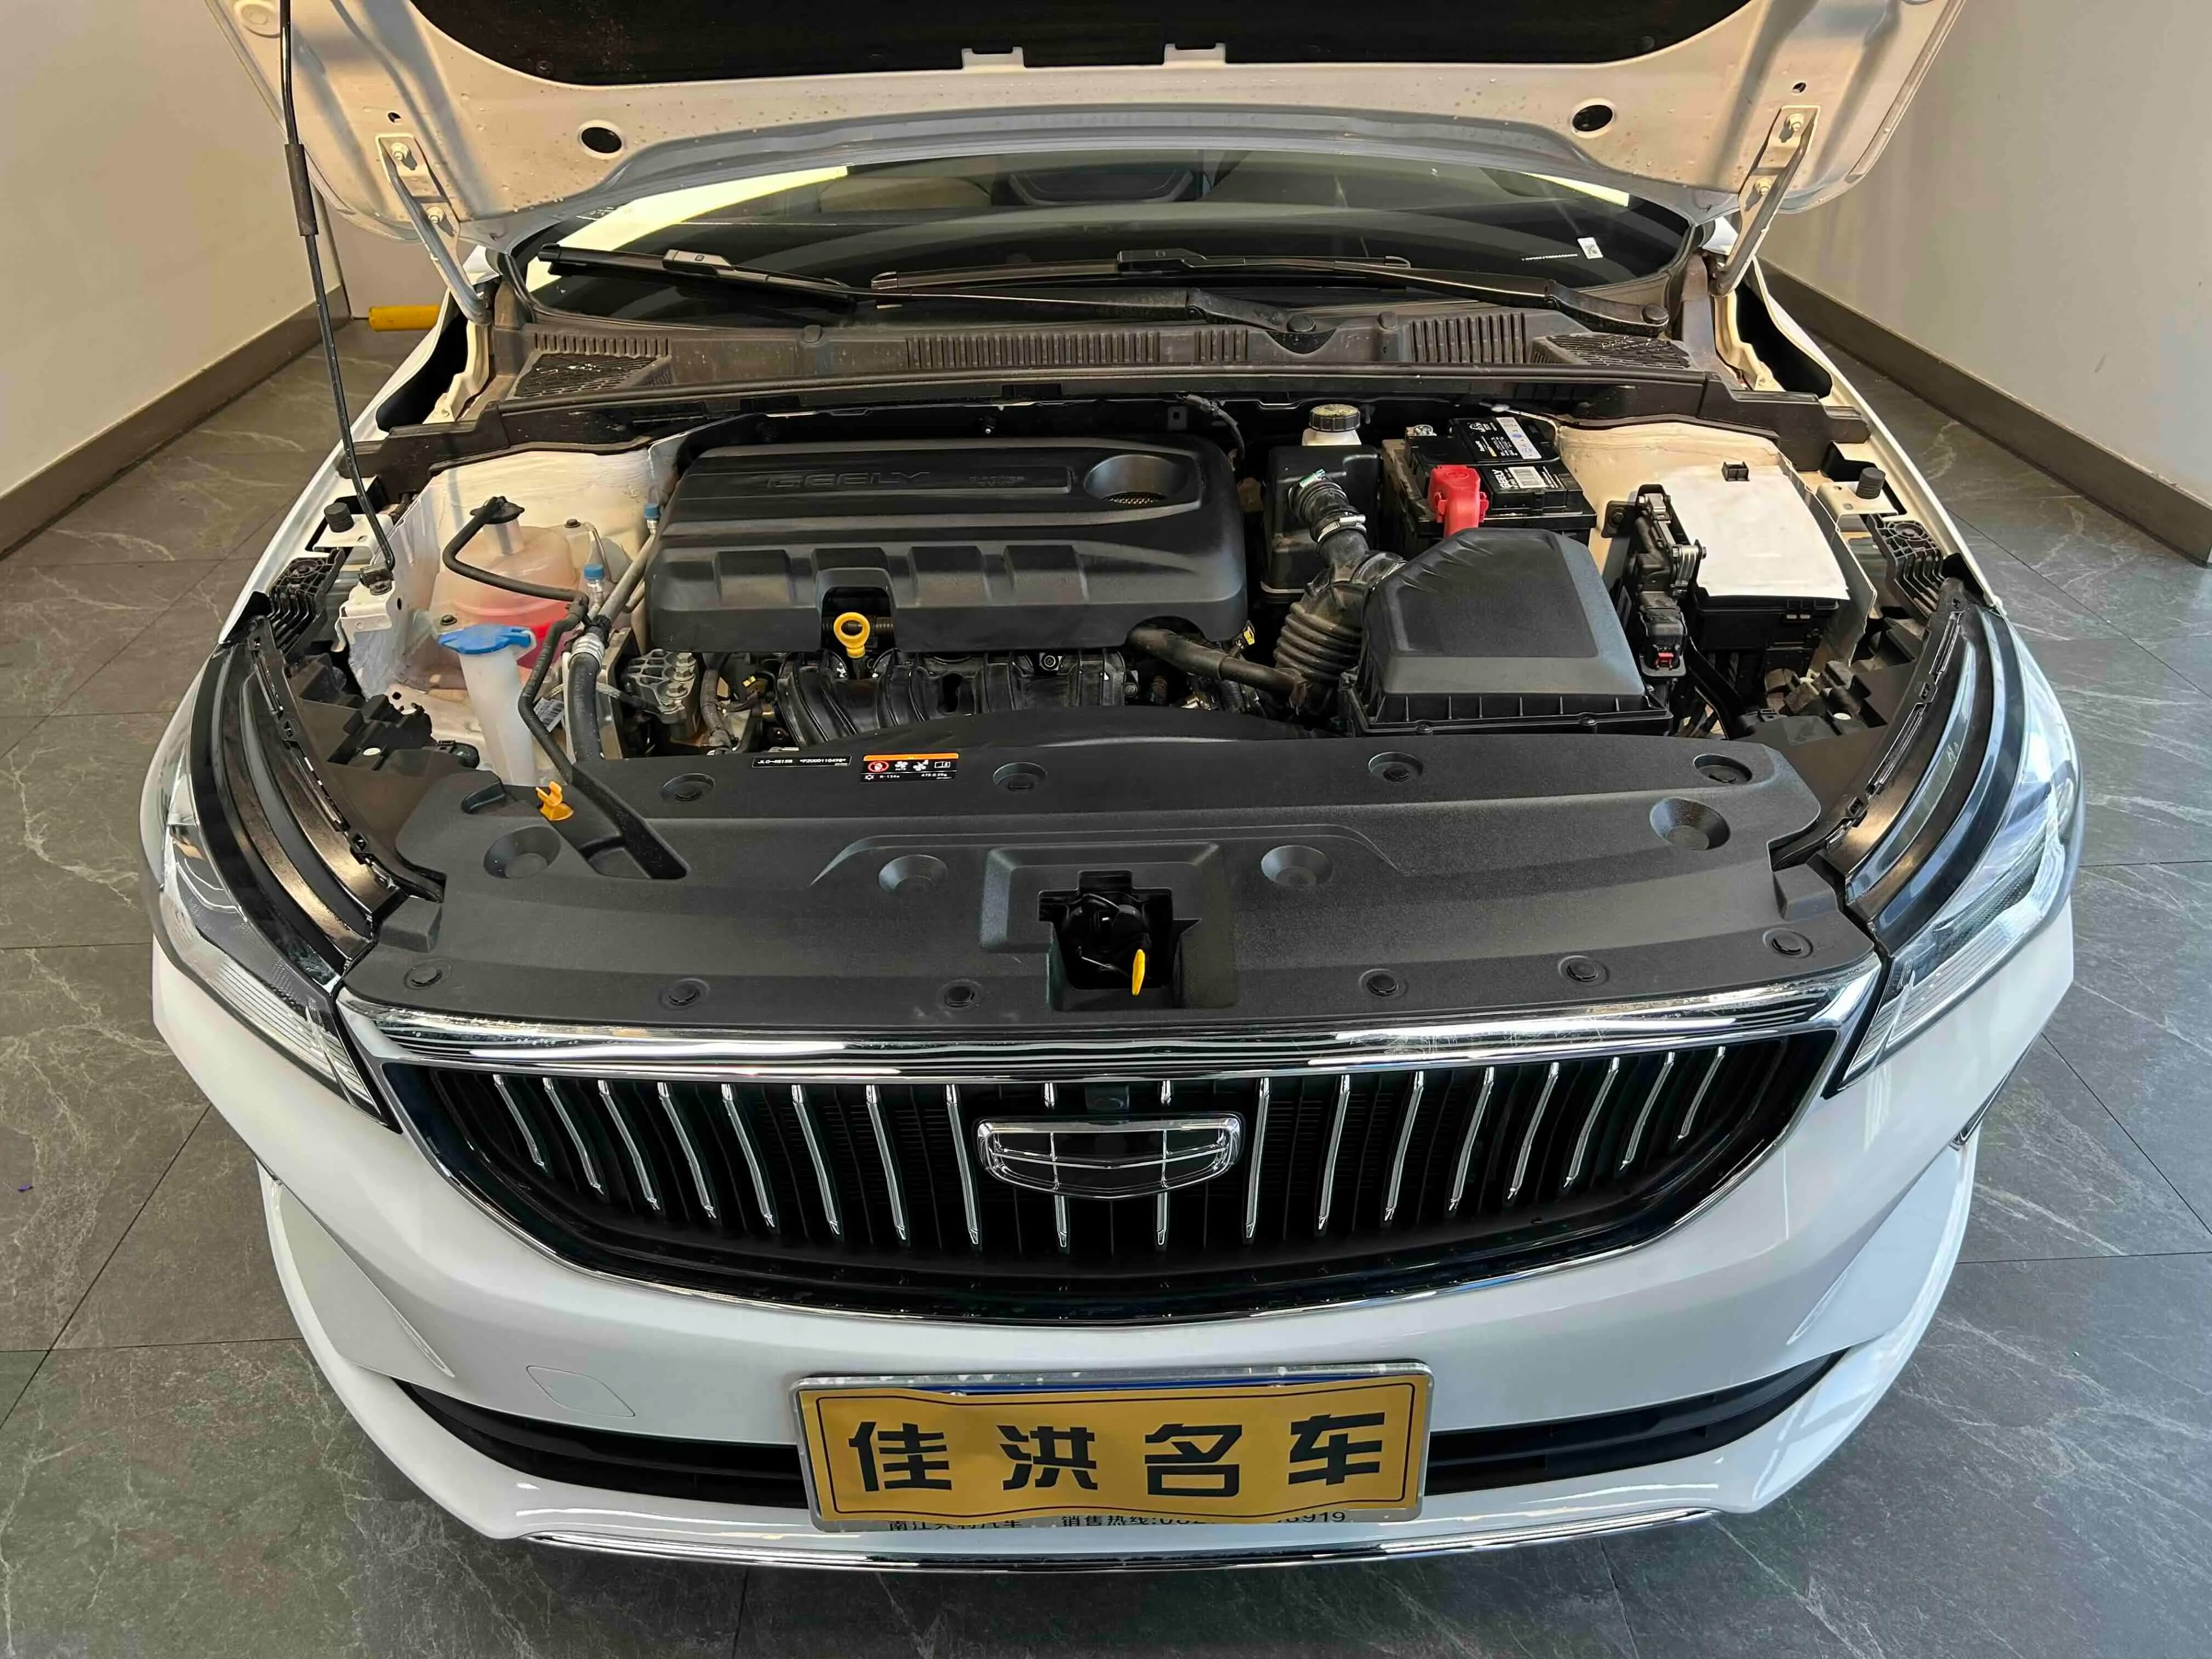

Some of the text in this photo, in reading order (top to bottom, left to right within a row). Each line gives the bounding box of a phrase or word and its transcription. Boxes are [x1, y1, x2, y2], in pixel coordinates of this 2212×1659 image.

[767, 471, 930, 488] GEELY
[1492, 469, 1510, 488] GEELY
[849, 1411, 1385, 1497] 佳洪名车
